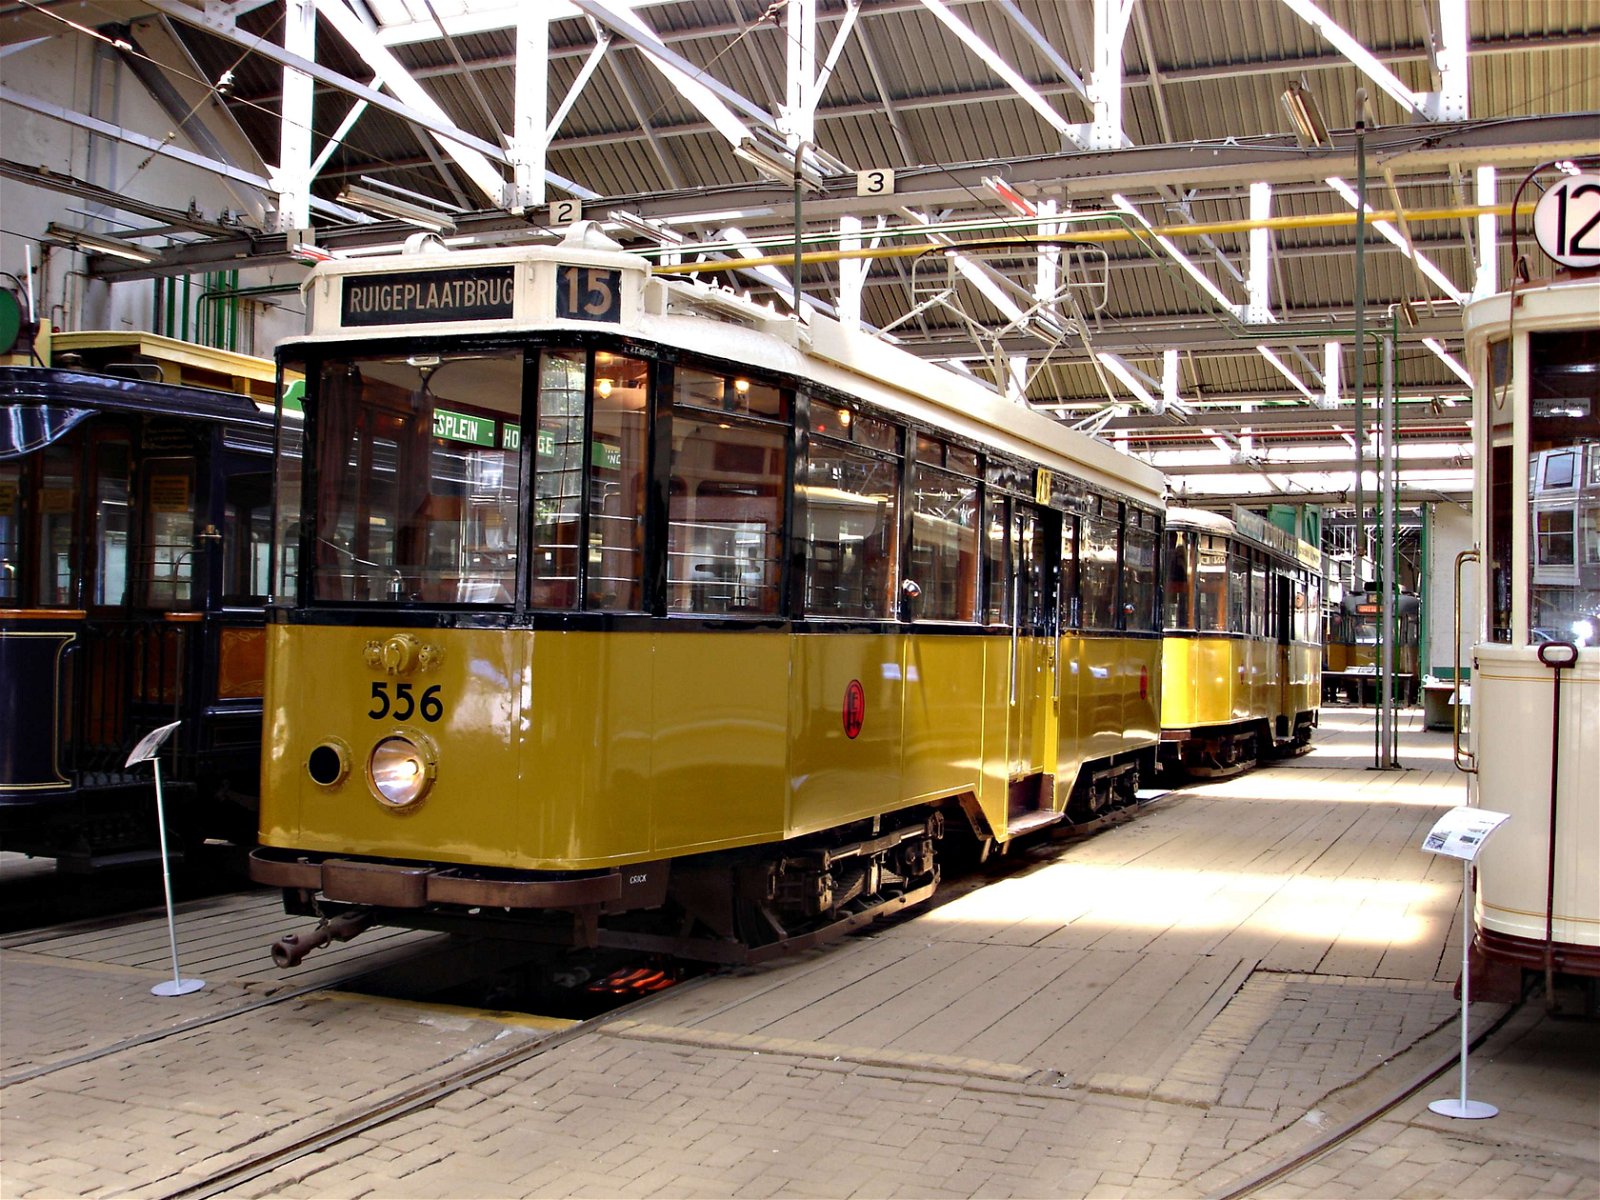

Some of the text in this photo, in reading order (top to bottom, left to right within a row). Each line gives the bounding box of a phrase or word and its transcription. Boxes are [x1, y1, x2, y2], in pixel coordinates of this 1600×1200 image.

[867, 172, 885, 193] 3
[557, 203, 573, 223] 2
[1553, 183, 1600, 256] 12
[349, 278, 515, 314] RUIGEPLAATBRUG
[564, 267, 612, 315] 15
[367, 681, 444, 723] 556
